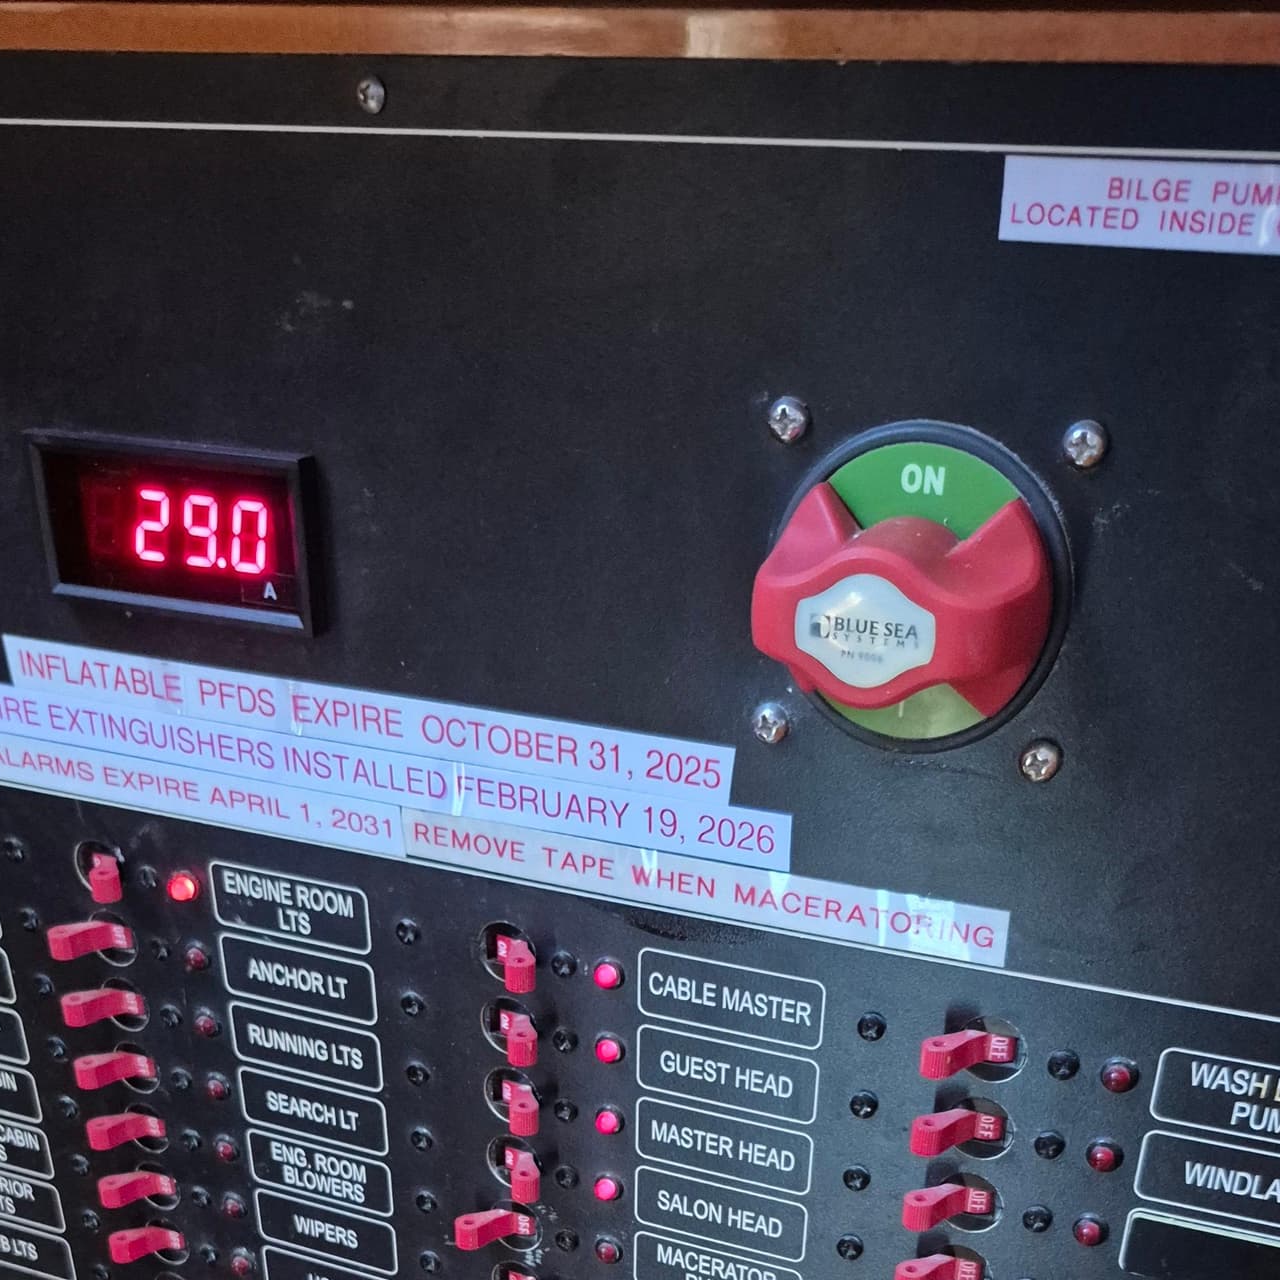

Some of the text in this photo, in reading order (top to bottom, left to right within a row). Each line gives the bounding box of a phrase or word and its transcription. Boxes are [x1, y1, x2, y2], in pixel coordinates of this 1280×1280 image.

[1107, 178, 1192, 204] BILGE
[1011, 203, 1140, 232] LOCATED
[1160, 210, 1254, 237] INSIDE
[900, 464, 946, 496] ON
[135, 489, 268, 574] 29.0
[264, 581, 277, 600] A
[832, 632, 919, 649] SYSTEMS
[834, 616, 918, 640] BLUE SEA
[19, 648, 721, 790] INFLATABLE PFDS EXPIRE OCTOBER 31, 2025
[48, 703, 276, 770] EXTINGUISHERS
[283, 747, 448, 799] INSTALLED
[457, 773, 629, 830] FEBRUARY
[642, 806, 686, 845] 19,
[697, 813, 776, 855] 2026
[103, 767, 200, 803] EXPIRE
[210, 785, 290, 821] APRIL
[300, 803, 323, 829] 1,
[331, 809, 394, 840] 2031
[223, 870, 354, 918] ENGINE ROOM
[414, 822, 995, 950] REMOVE TAPE WHEN MACERATORING
[278, 906, 312, 935] LTS
[248, 956, 348, 1000] ANCHOR LT
[648, 972, 812, 1027] CABLE MASTER
[248, 1026, 363, 1069] RUNNING LTS
[659, 1050, 794, 1100] GUEST HEAD
[1190, 1060, 1270, 1098] WASH
[266, 1090, 359, 1131] SEARCH LT
[270, 1141, 367, 1183] ENG. ROOM
[650, 1120, 796, 1173] MASTER HEAD
[282, 1163, 365, 1202] BLOWERS
[293, 1213, 359, 1249] WIPERS
[656, 1189, 783, 1239] SALON HEAD
[11, 1235, 39, 1260] LTS
